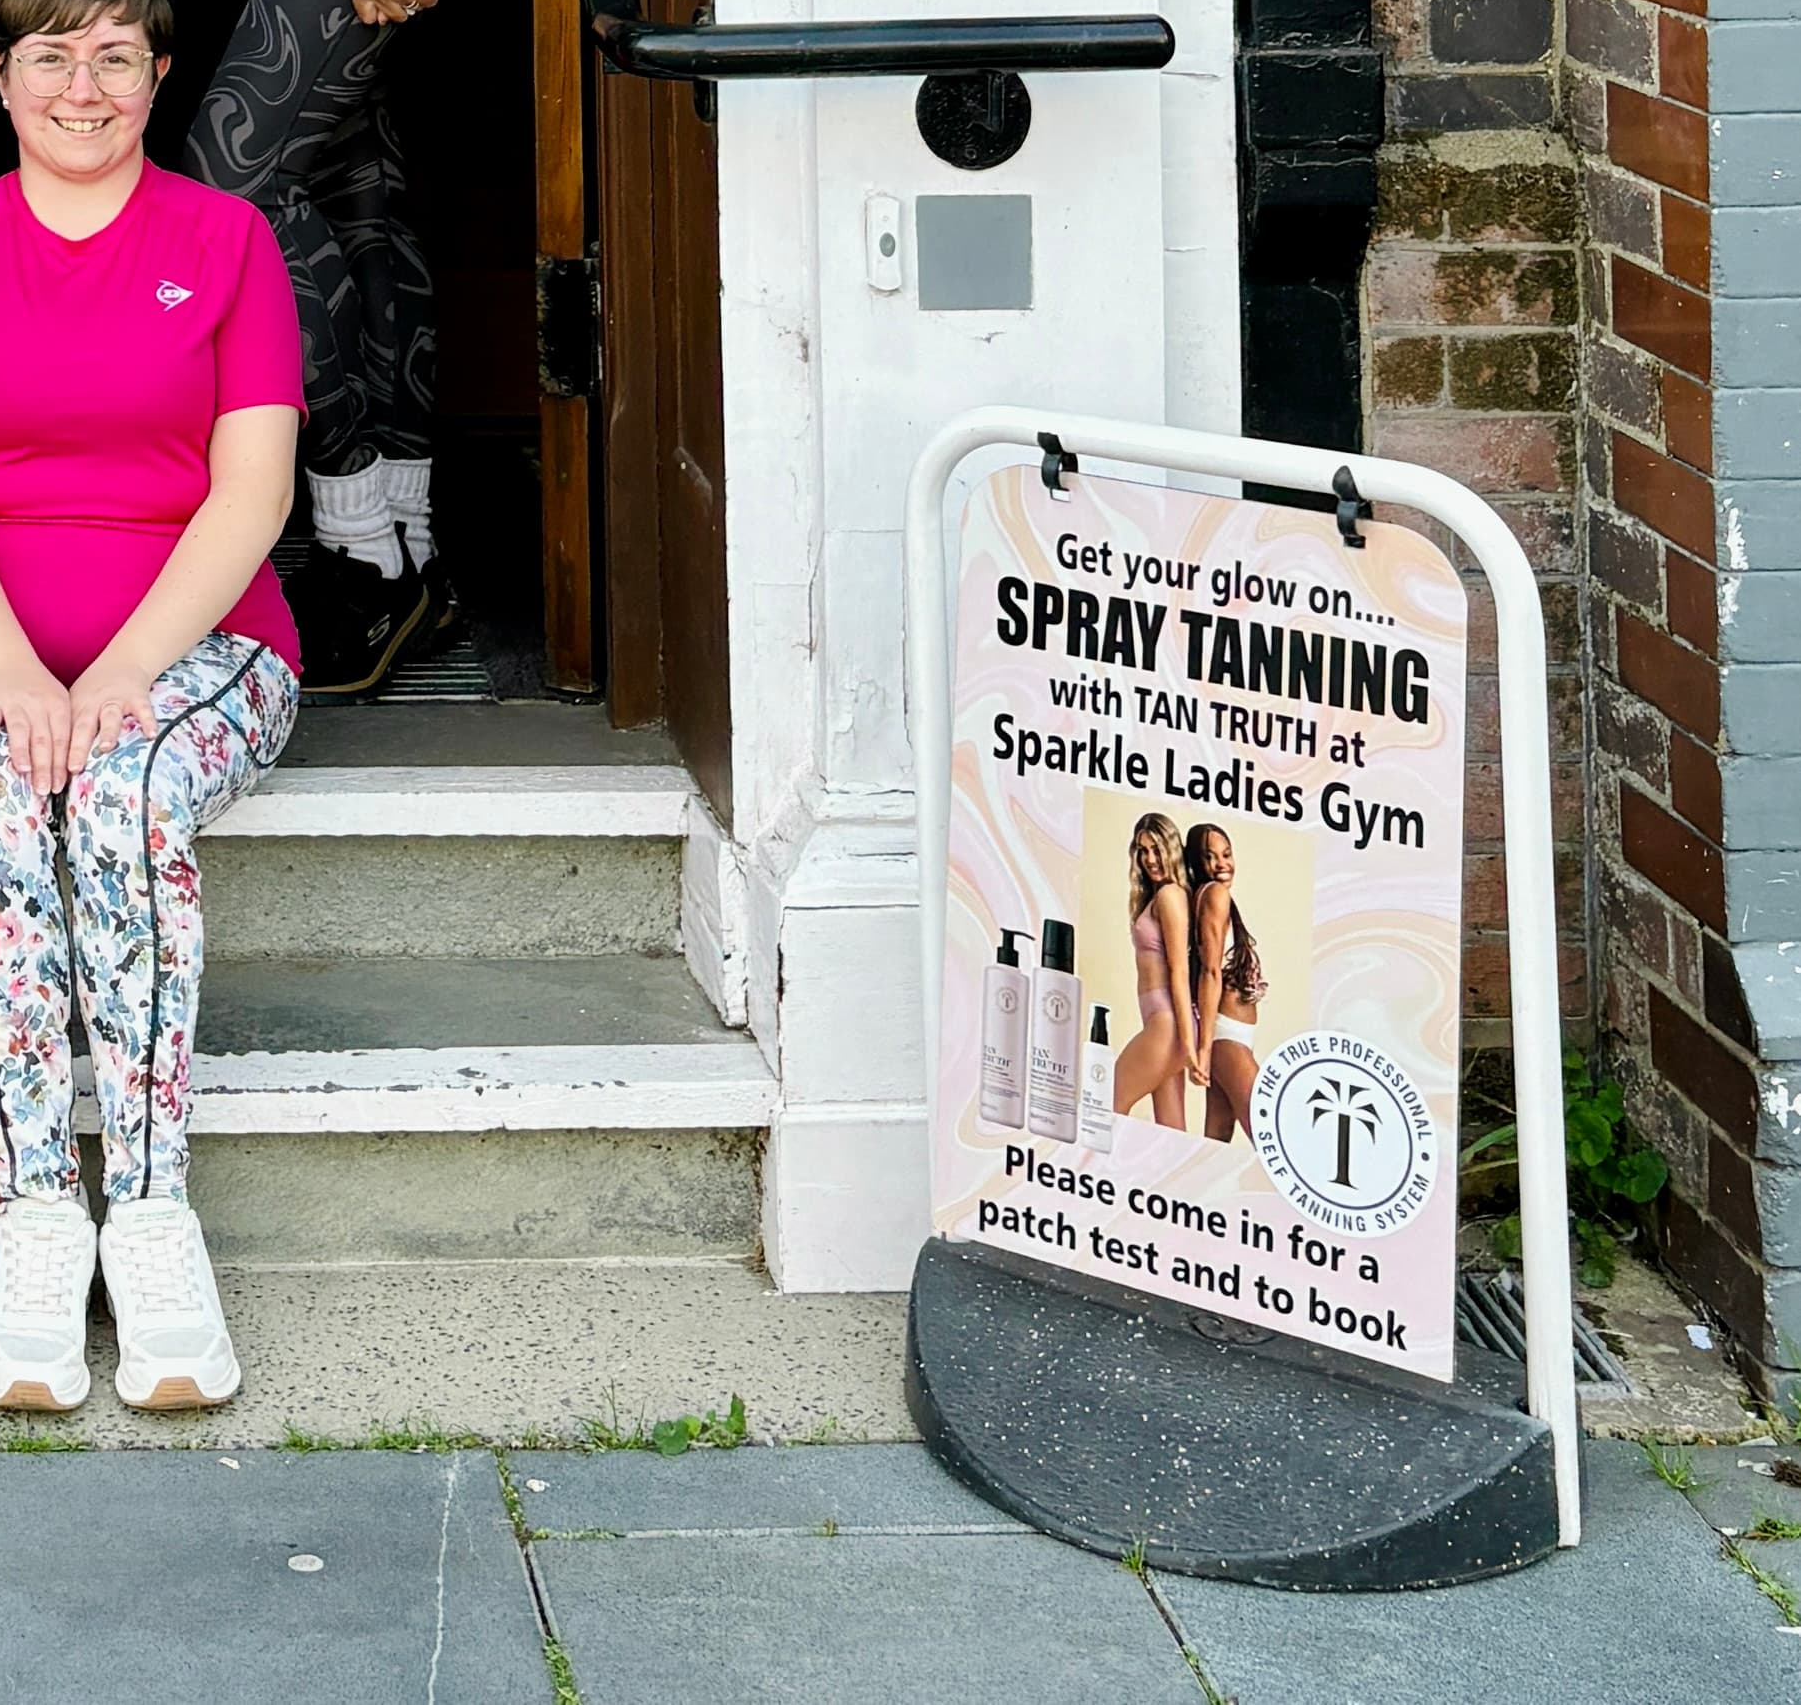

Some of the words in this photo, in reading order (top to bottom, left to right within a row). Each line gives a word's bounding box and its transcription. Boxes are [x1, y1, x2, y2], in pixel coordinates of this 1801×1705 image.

[1057, 534, 1112, 576] Get
[1124, 554, 1200, 590] your
[1212, 561, 1296, 607] glow
[1310, 586, 1393, 625] on....
[998, 577, 1167, 671] SPRAY
[1179, 610, 1429, 727] TANNING
[1050, 674, 1121, 717] with
[1135, 687, 1197, 733] TAN
[1210, 702, 1316, 757] TRUTH
[1331, 732, 1364, 767] at
[994, 714, 1148, 788] Sparkle
[1165, 749, 1303, 821] Ladies
[1321, 782, 1423, 849] Gym
[1258, 1065, 1281, 1098] THE
[1279, 1037, 1320, 1065] TRUE
[1329, 1037, 1432, 1140] PROFESSIONAL
[1006, 1145, 1115, 1205] Please
[1129, 1189, 1226, 1237] come
[1242, 1210, 1273, 1252] in
[1288, 1225, 1345, 1271] for
[1359, 1256, 1378, 1283] a
[1258, 1131, 1288, 1177] SELF
[1288, 1183, 1367, 1232] TANNING
[1375, 1173, 1429, 1229] SYSTEM
[980, 1200, 1075, 1249] patch
[1090, 1227, 1158, 1275] test
[1172, 1258, 1239, 1299] and
[1255, 1276, 1293, 1314] to
[1310, 1287, 1406, 1350] book
